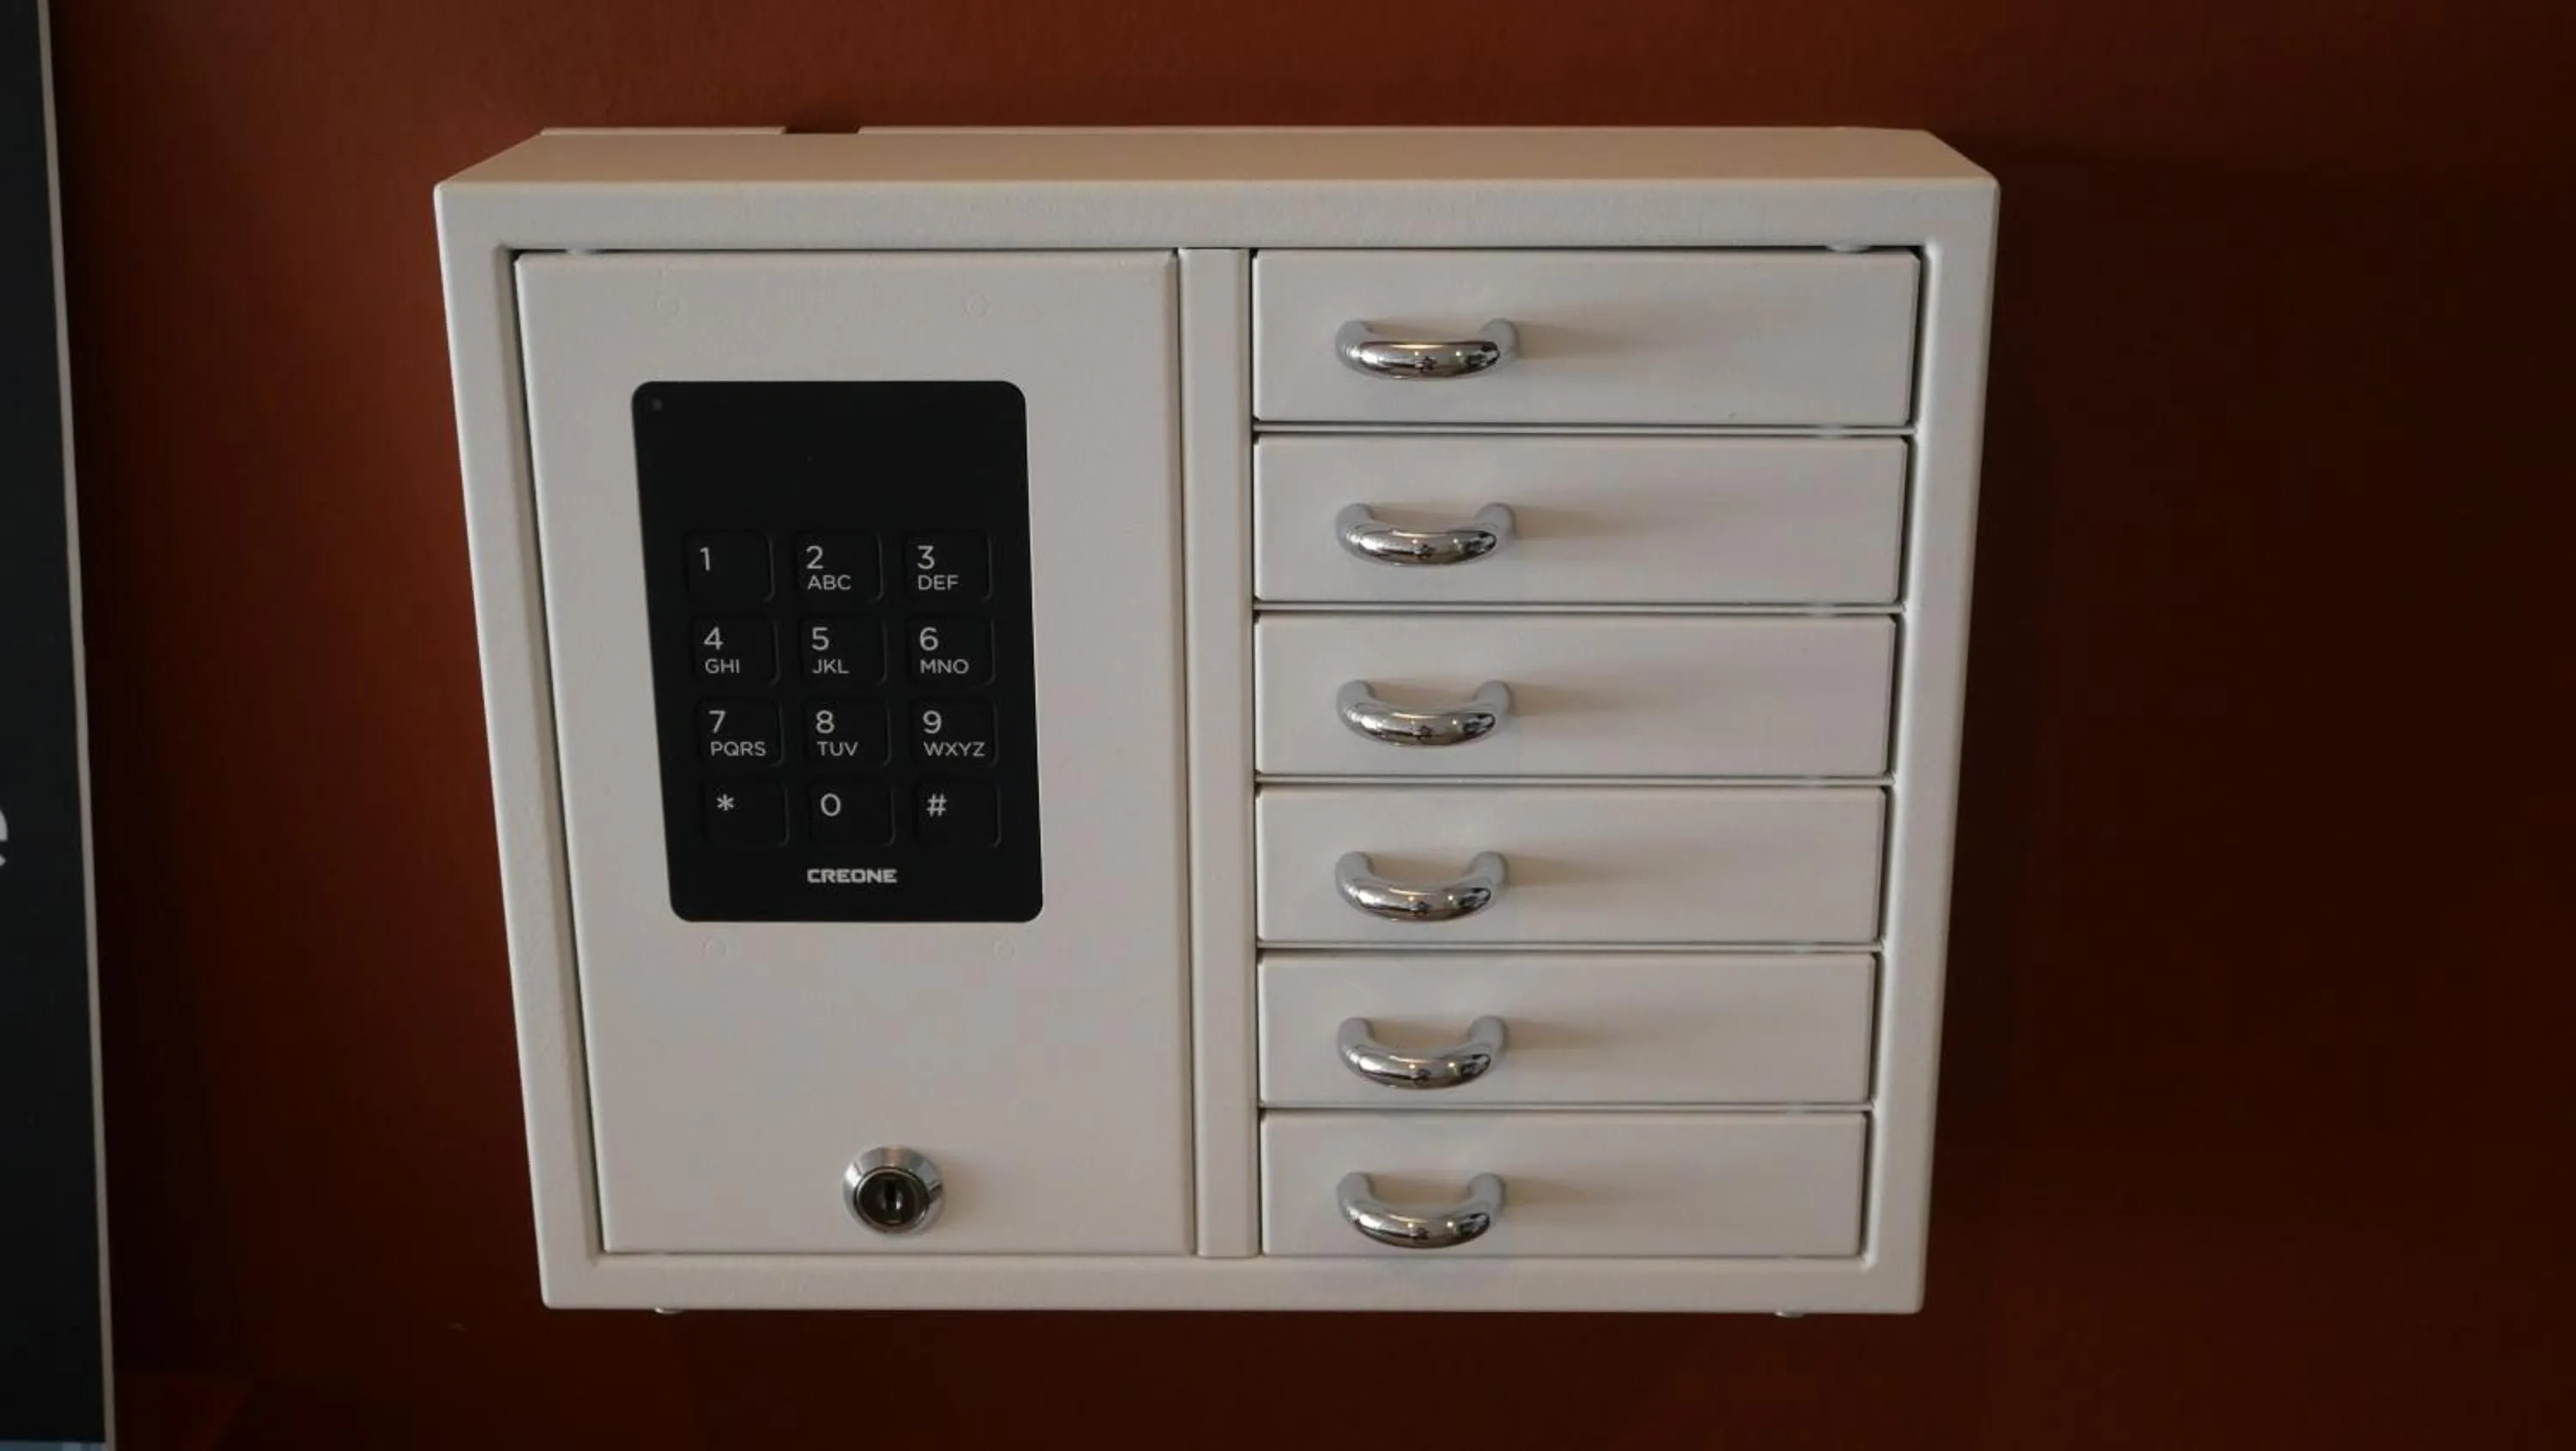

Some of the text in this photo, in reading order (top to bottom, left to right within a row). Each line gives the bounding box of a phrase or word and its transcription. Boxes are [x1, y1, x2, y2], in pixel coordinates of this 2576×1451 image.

[700, 547, 711, 571] 1
[806, 545, 824, 569] 2
[917, 545, 936, 569] 3
[807, 574, 852, 591] ABC
[918, 574, 959, 591] DEF
[703, 627, 724, 650] 4
[812, 627, 829, 651] 5
[920, 626, 939, 652] 6
[704, 659, 740, 674] GHI
[812, 659, 849, 674] JKL
[920, 659, 969, 674] MNO
[708, 710, 726, 733] 7
[816, 709, 835, 734] 8
[922, 710, 942, 734] 9
[710, 741, 767, 758] PQRS
[817, 741, 859, 756] TUV
[923, 741, 986, 757] WXYZ
[820, 792, 841, 817] 0
[927, 793, 947, 817] #
[806, 868, 897, 883] CREONE
